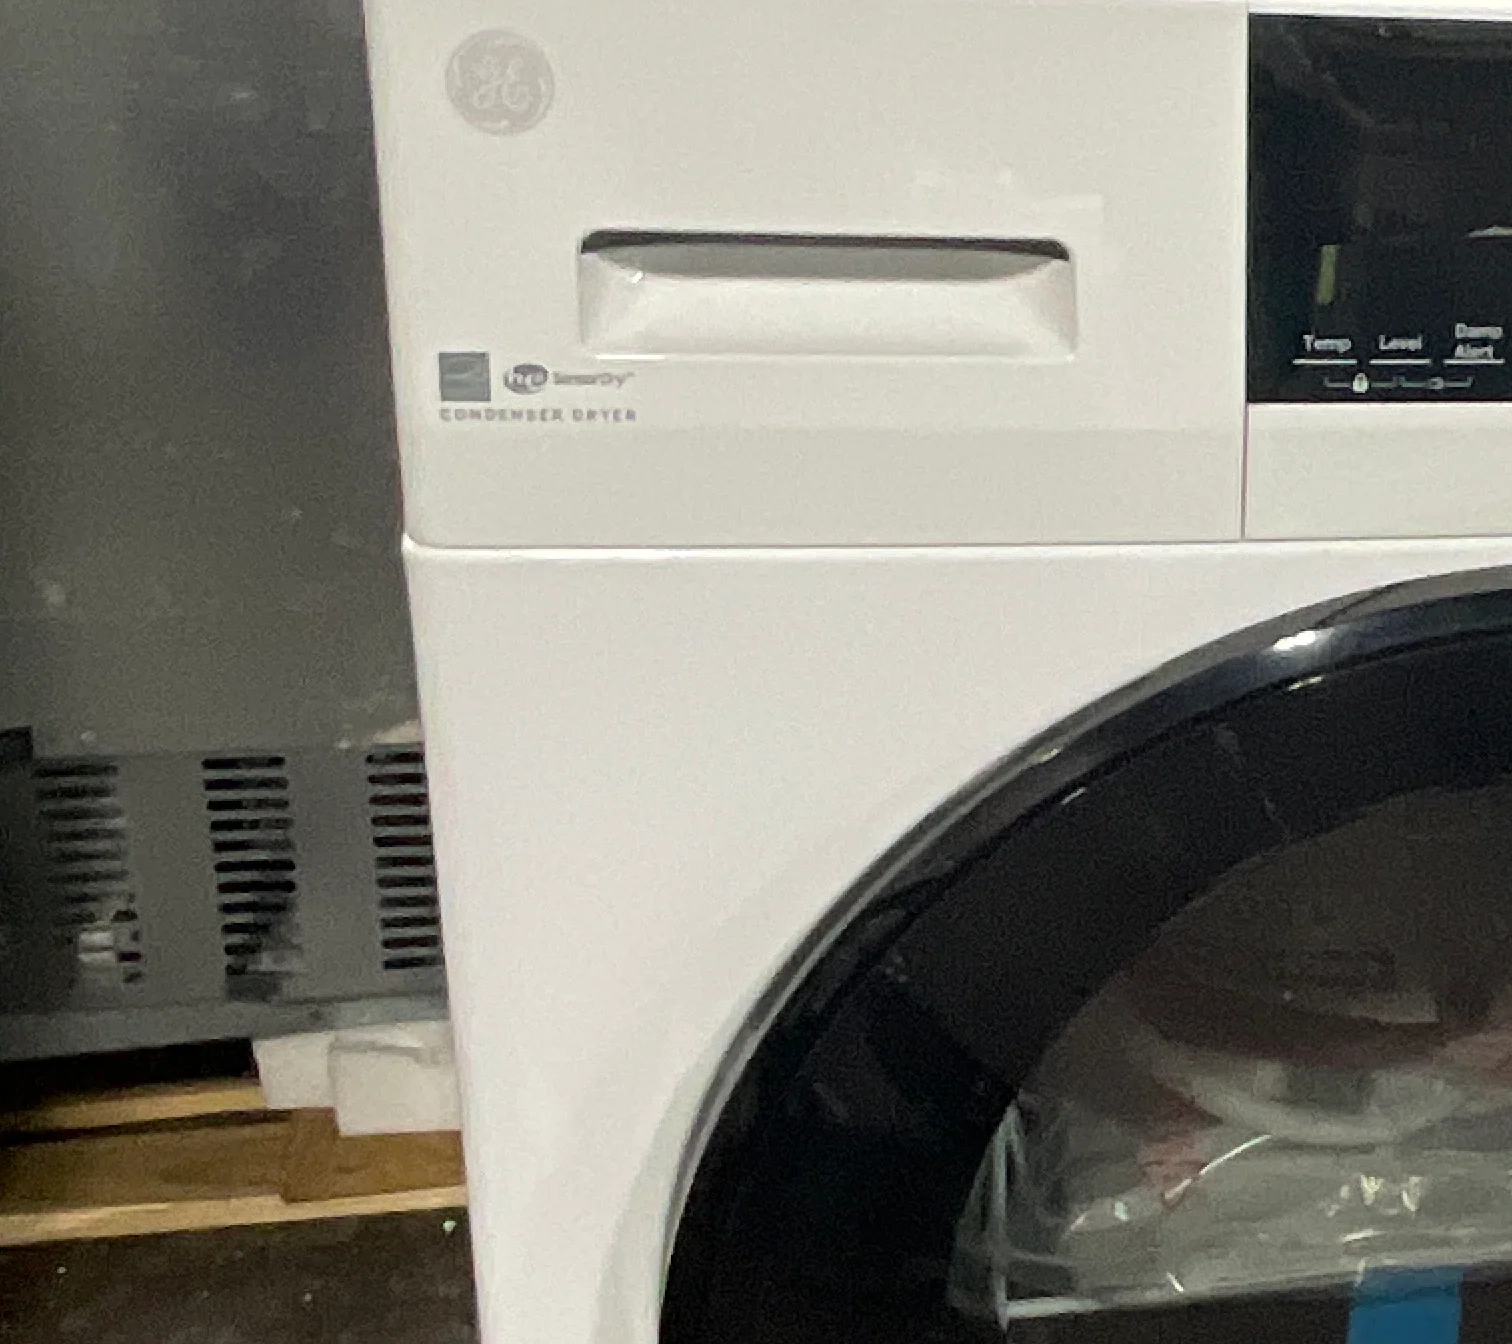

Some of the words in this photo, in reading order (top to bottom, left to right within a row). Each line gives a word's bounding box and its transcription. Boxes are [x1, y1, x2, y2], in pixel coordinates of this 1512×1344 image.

[1302, 334, 1351, 354] Temp
[1378, 334, 1423, 351] Level
[1454, 343, 1494, 359] Alert
[438, 407, 564, 423] CONDENSER
[571, 407, 637, 423] DRYER
